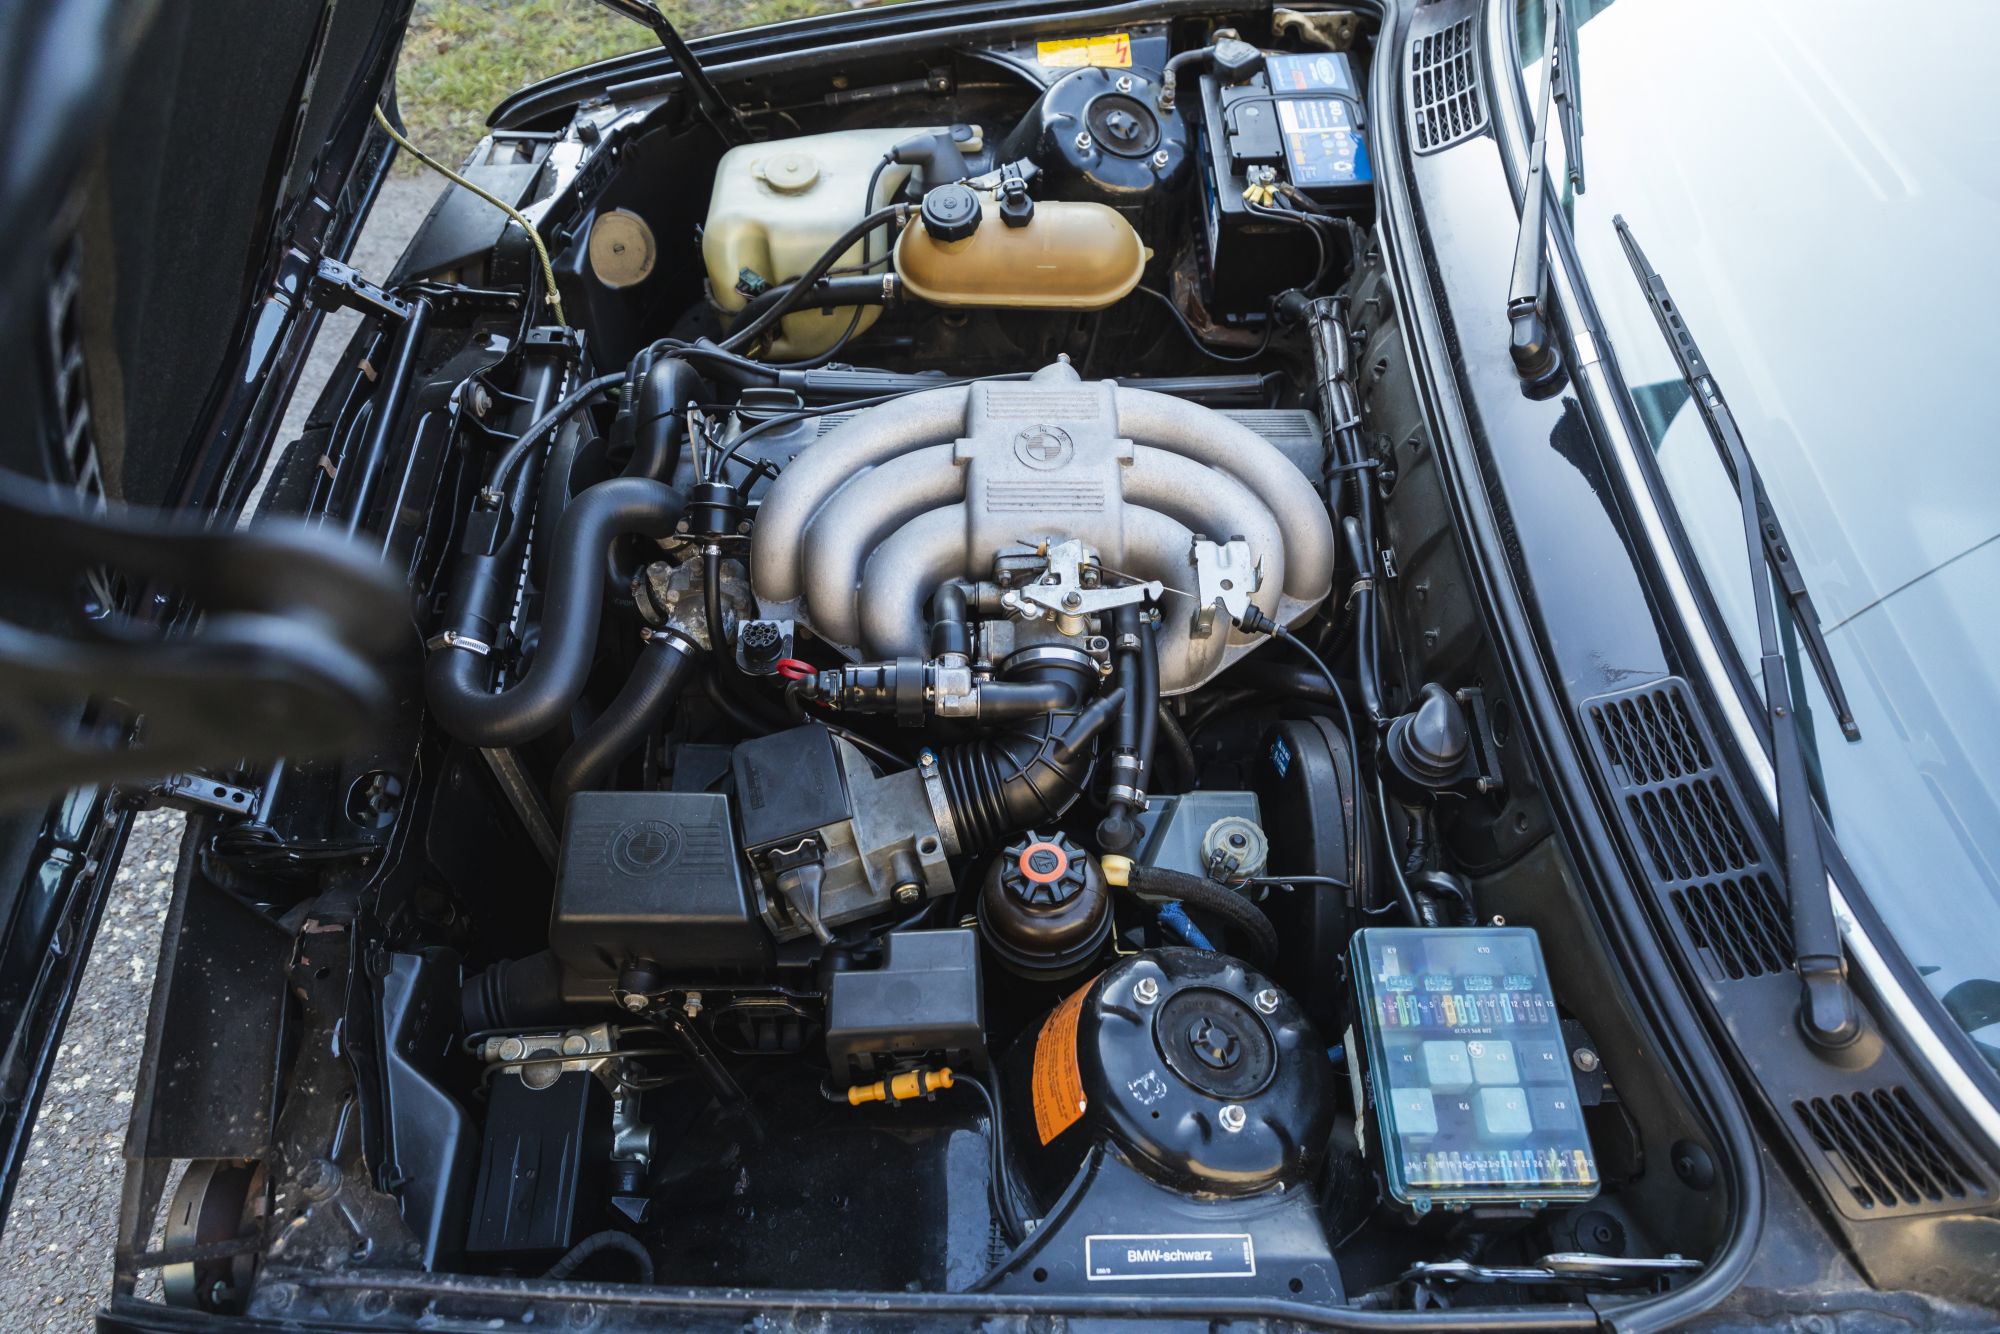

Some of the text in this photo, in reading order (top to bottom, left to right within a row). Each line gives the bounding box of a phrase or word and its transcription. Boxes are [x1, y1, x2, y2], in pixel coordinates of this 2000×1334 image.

[1543, 1053, 1553, 1061] K4
[1459, 1103, 1470, 1111] K6
[1554, 1102, 1565, 1110] K8
[1127, 1249, 1213, 1263] BMW-schwarz
